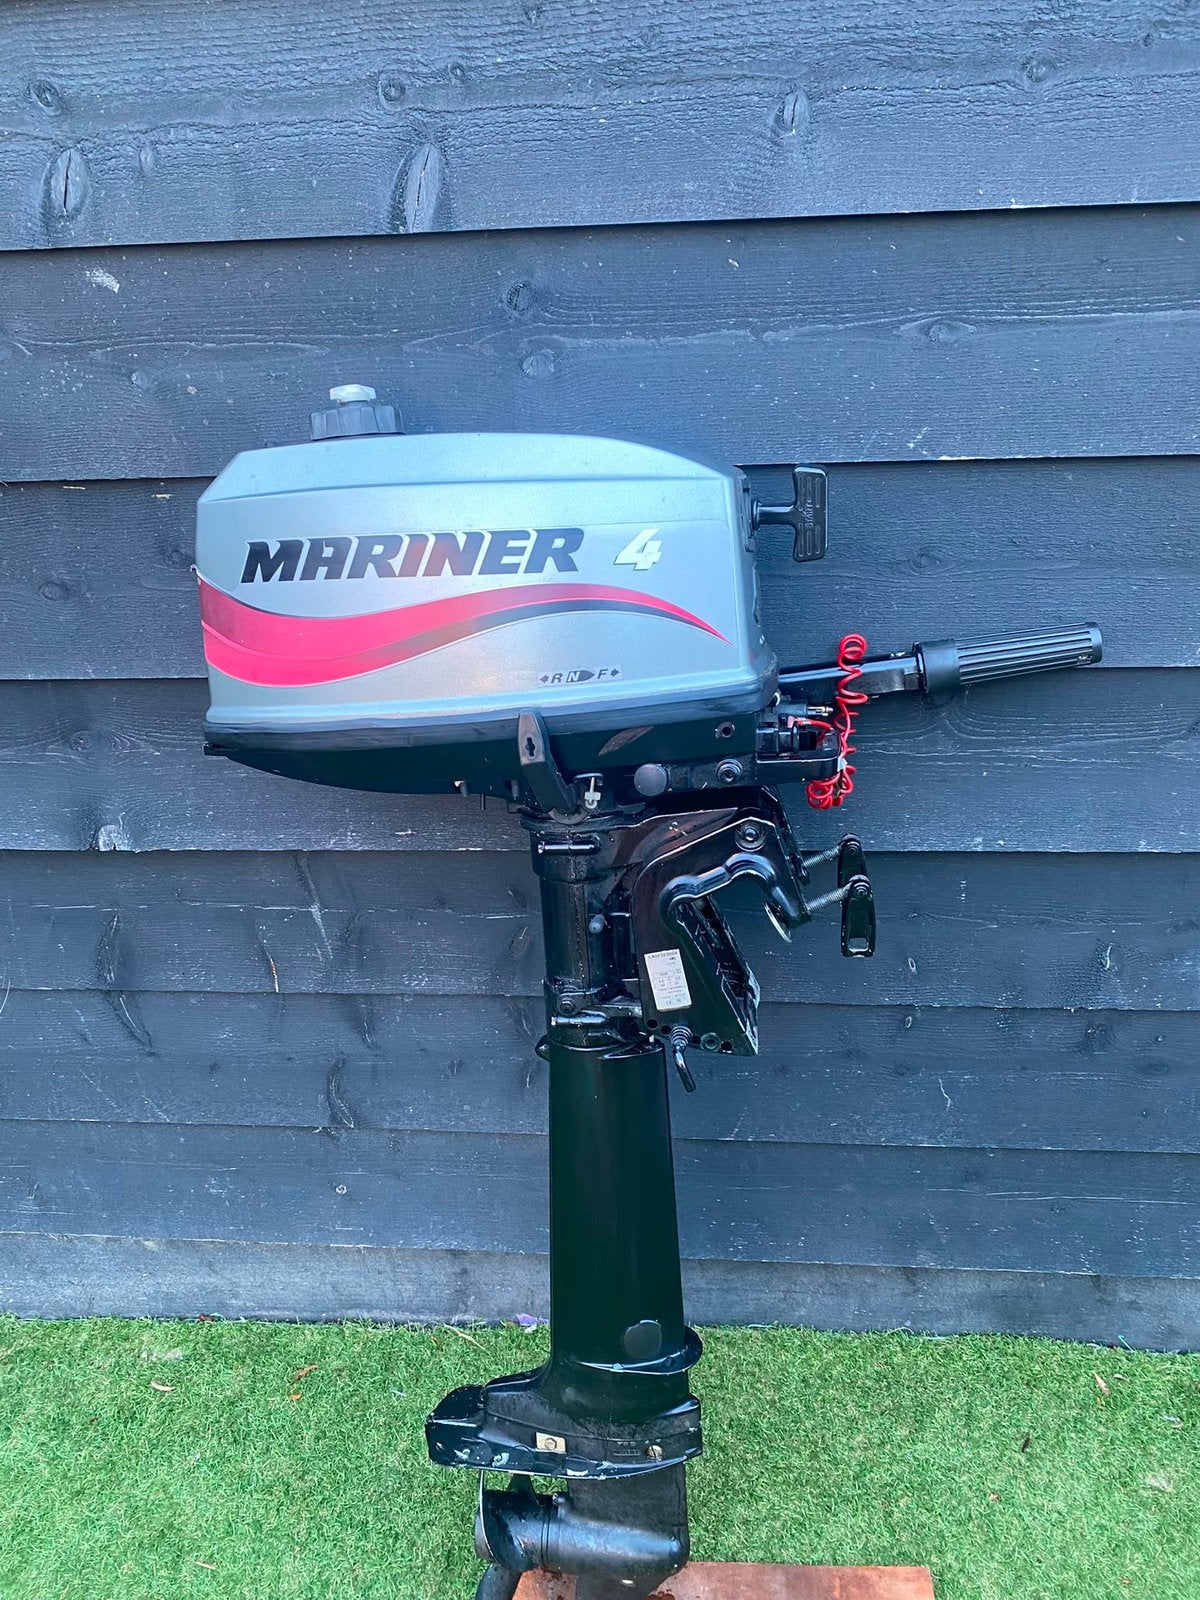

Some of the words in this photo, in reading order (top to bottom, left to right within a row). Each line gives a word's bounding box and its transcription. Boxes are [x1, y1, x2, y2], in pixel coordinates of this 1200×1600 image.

[804, 502, 814, 529] START
[240, 527, 585, 584] MARINER
[613, 527, 663, 571] 4
[551, 673, 563, 684] R
[567, 671, 581, 683] N
[597, 668, 609, 680] F
